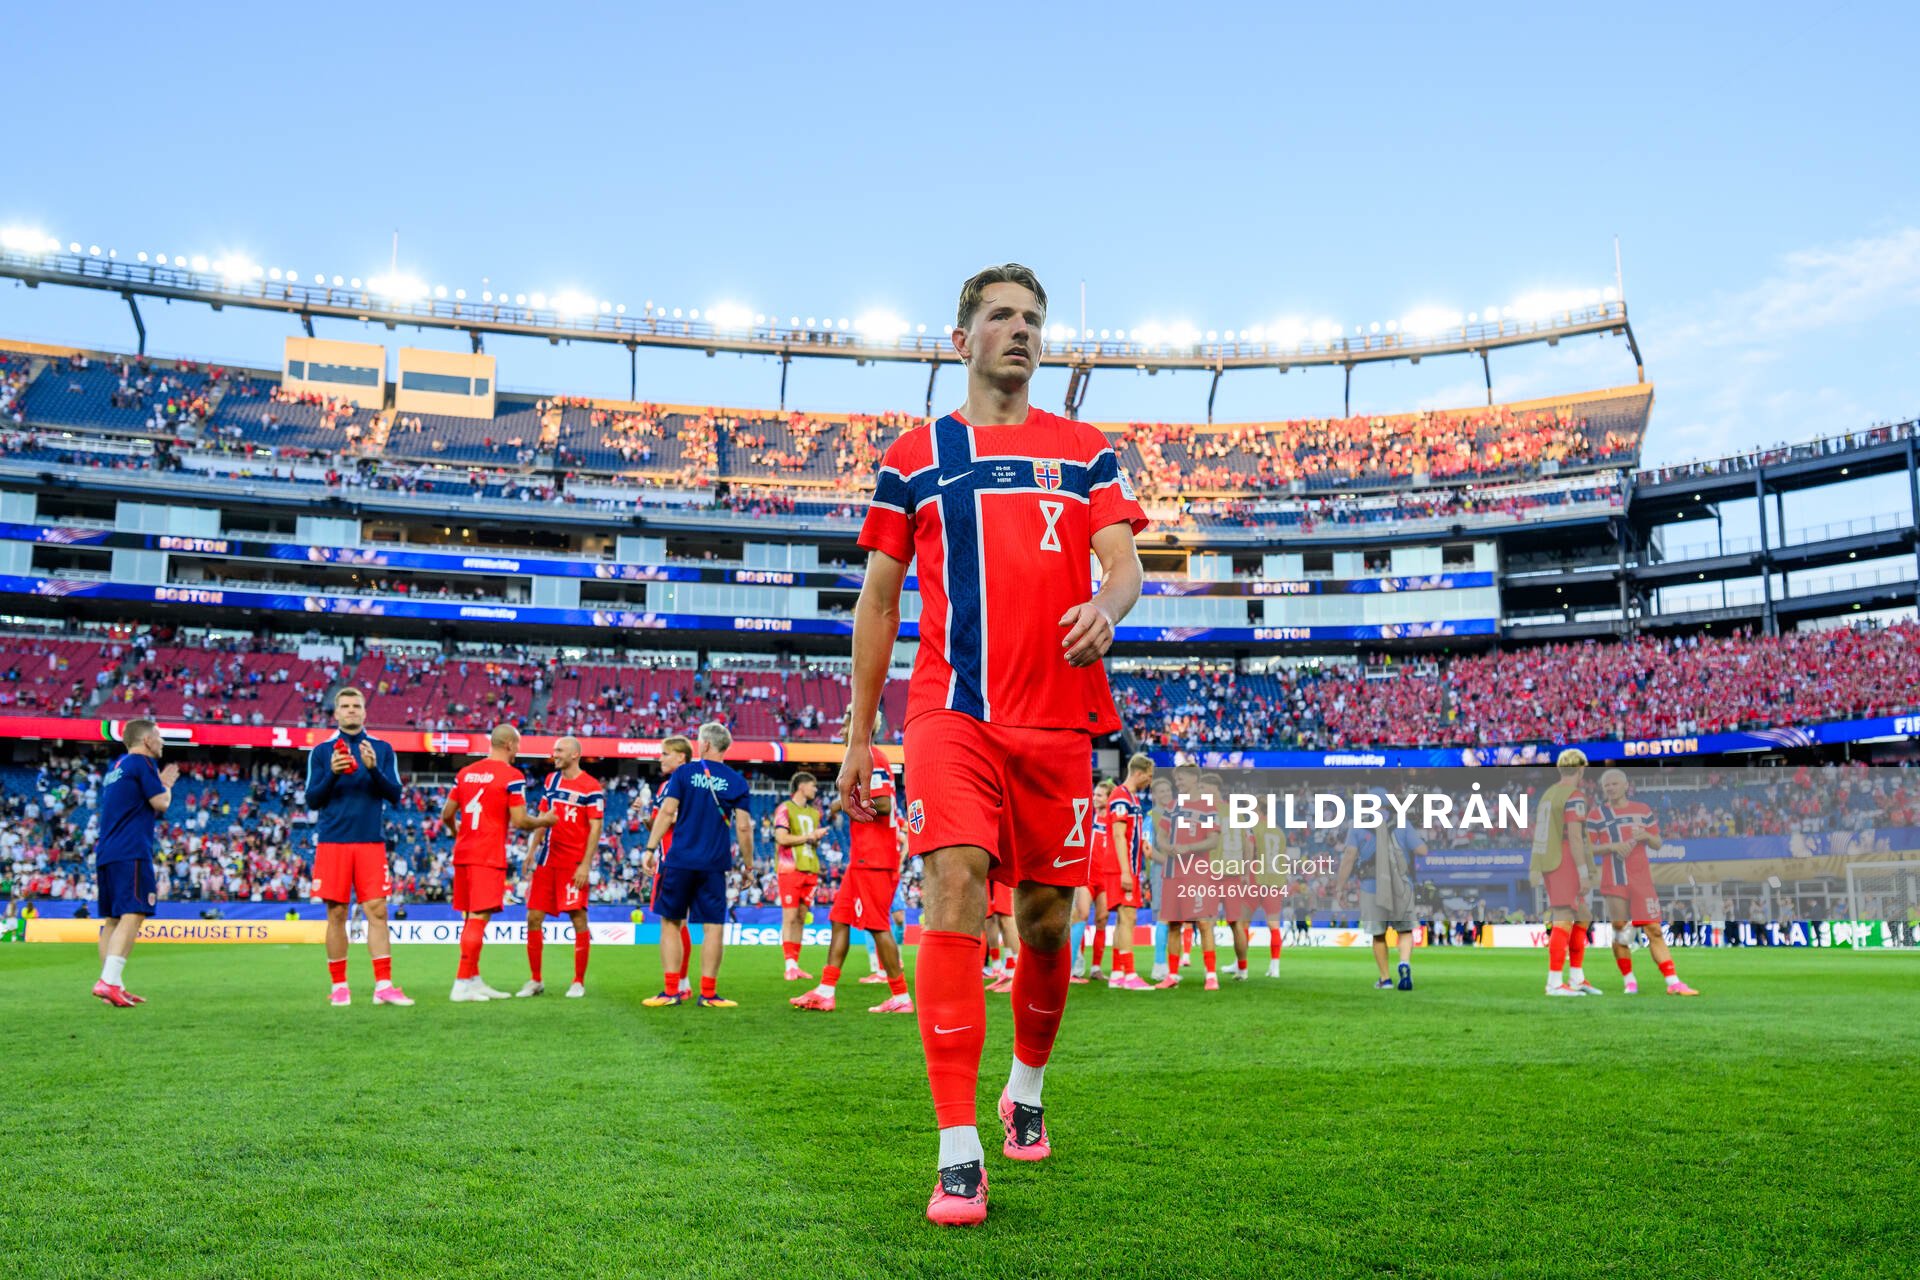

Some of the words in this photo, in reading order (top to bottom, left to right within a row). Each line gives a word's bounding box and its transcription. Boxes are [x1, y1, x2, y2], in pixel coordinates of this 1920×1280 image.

[1039, 499, 1064, 552] 8
[159, 536, 228, 553] BOSTON
[736, 570, 793, 584] BOSTON
[154, 587, 223, 604] BOSTON
[1253, 582, 1310, 594] BOSTON
[734, 617, 792, 631] BOSTON
[1254, 628, 1311, 640] BOSTON
[272, 727, 292, 746] 1
[1624, 738, 1698, 757] BOSTON
[465, 788, 482, 830] 4
[564, 805, 577, 823] 14
[1064, 798, 1089, 847] 8
[723, 923, 832, 946] isese
